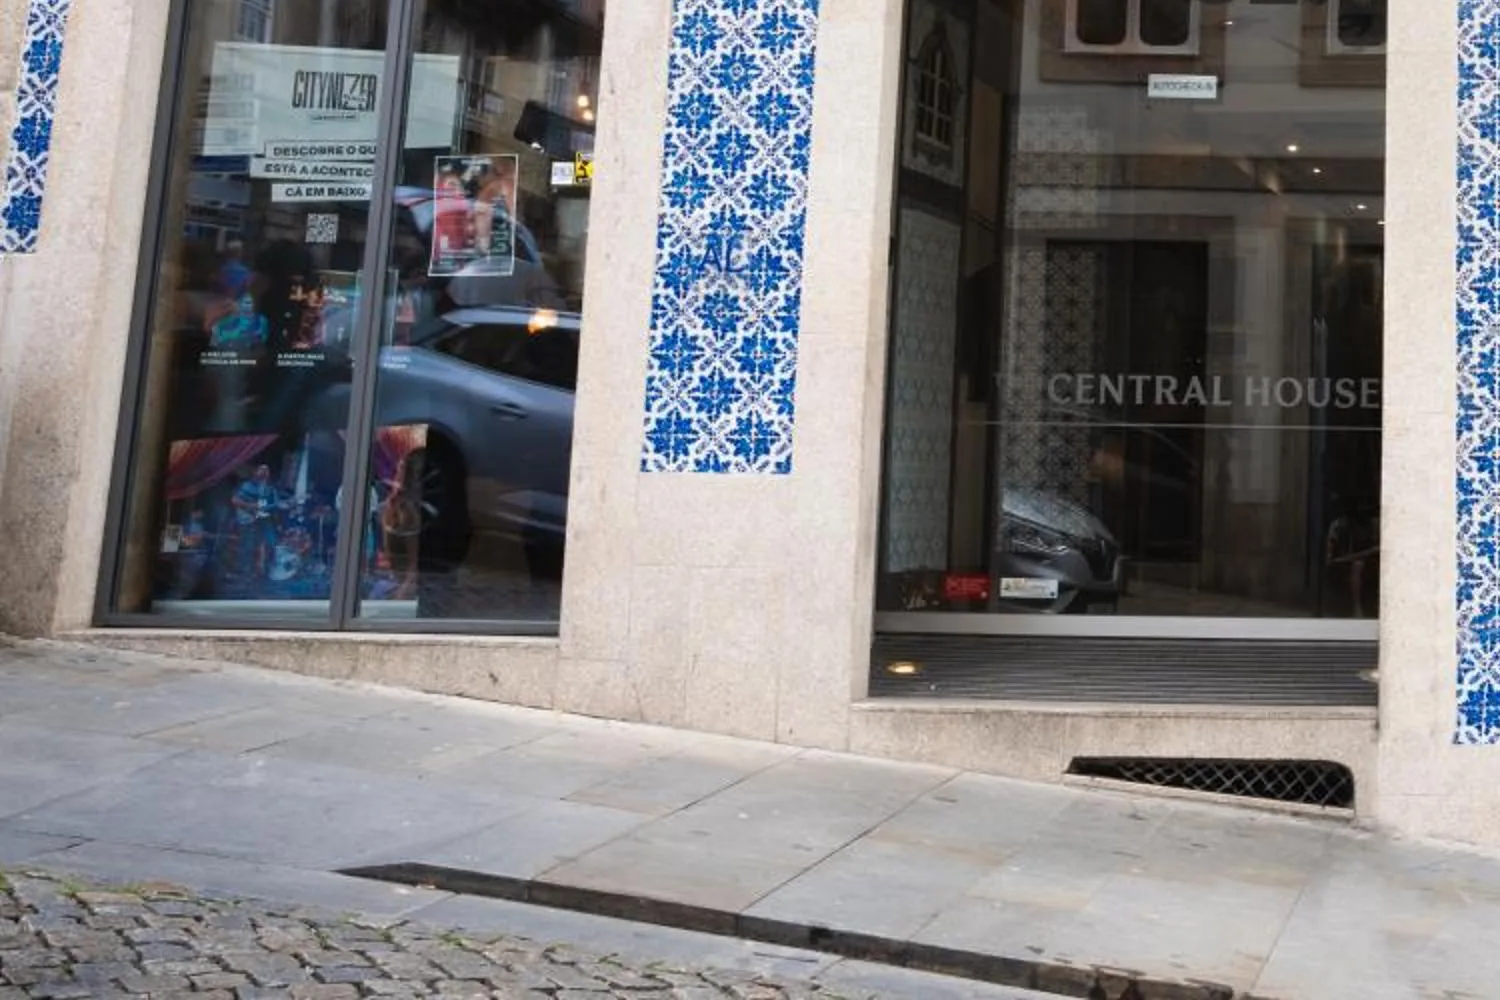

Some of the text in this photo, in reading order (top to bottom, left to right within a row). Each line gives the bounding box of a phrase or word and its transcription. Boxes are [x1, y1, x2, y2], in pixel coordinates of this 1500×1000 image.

[291, 69, 378, 113] CITYNIZER
[273, 145, 376, 157] DESCOBRE O QU
[299, 165, 308, 176] A
[311, 165, 374, 178] ACONTEC
[306, 187, 324, 197] EM
[1047, 373, 1233, 407] CENTRAL
[1244, 376, 1381, 409] HOUSE
